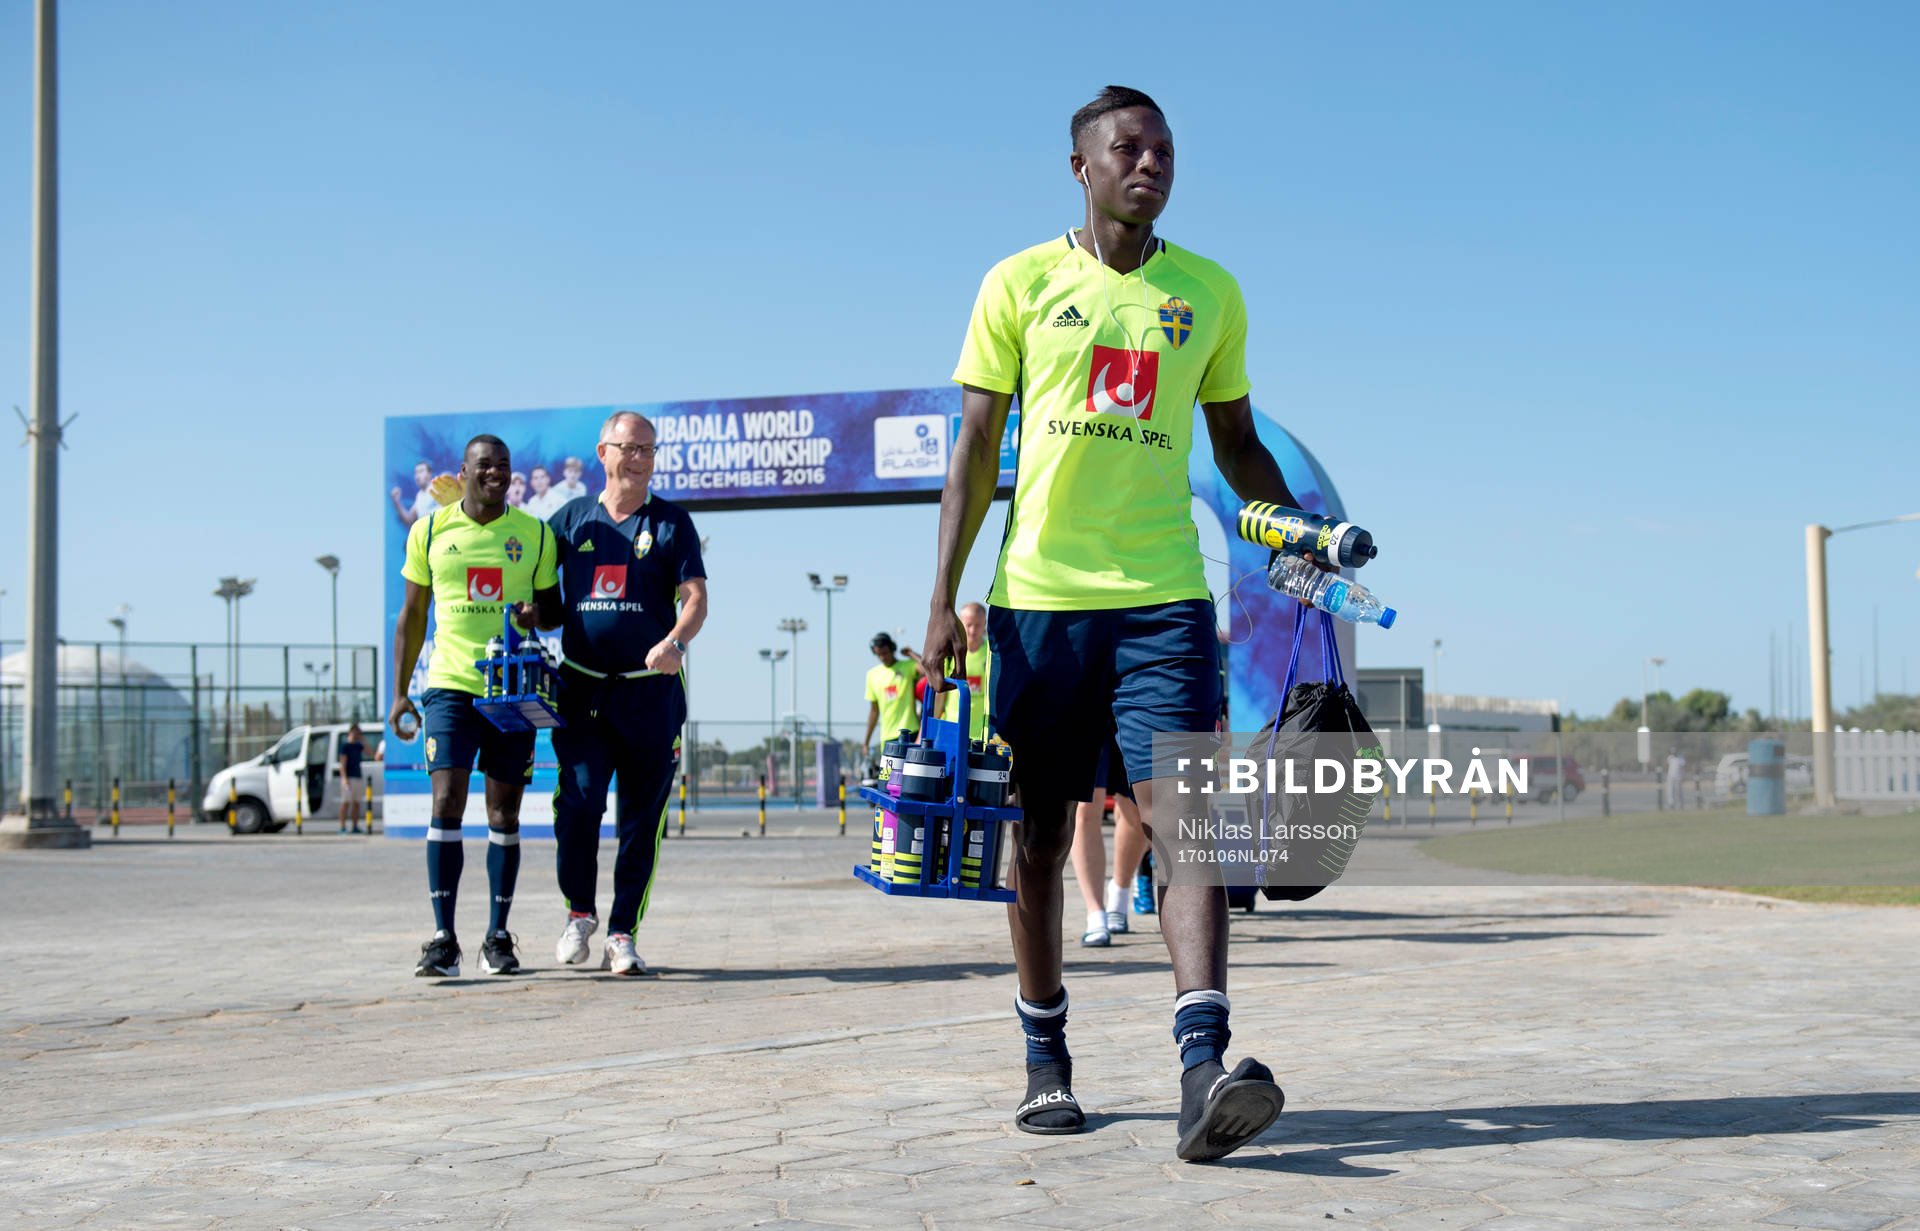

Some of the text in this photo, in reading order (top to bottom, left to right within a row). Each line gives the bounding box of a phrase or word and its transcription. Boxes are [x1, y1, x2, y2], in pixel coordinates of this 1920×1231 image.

[1053, 318, 1090, 328] adidas
[649, 409, 815, 444] UBADALA WORLD
[1048, 420, 1173, 450] SVENSKA SPEL
[653, 437, 833, 473] NIS CHAMPIONSHIP
[675, 469, 778, 490] DECEMBER
[782, 467, 826, 486] 2016
[449, 605, 496, 615] SVENSKA
[576, 600, 644, 613] SVENSKA SPEL
